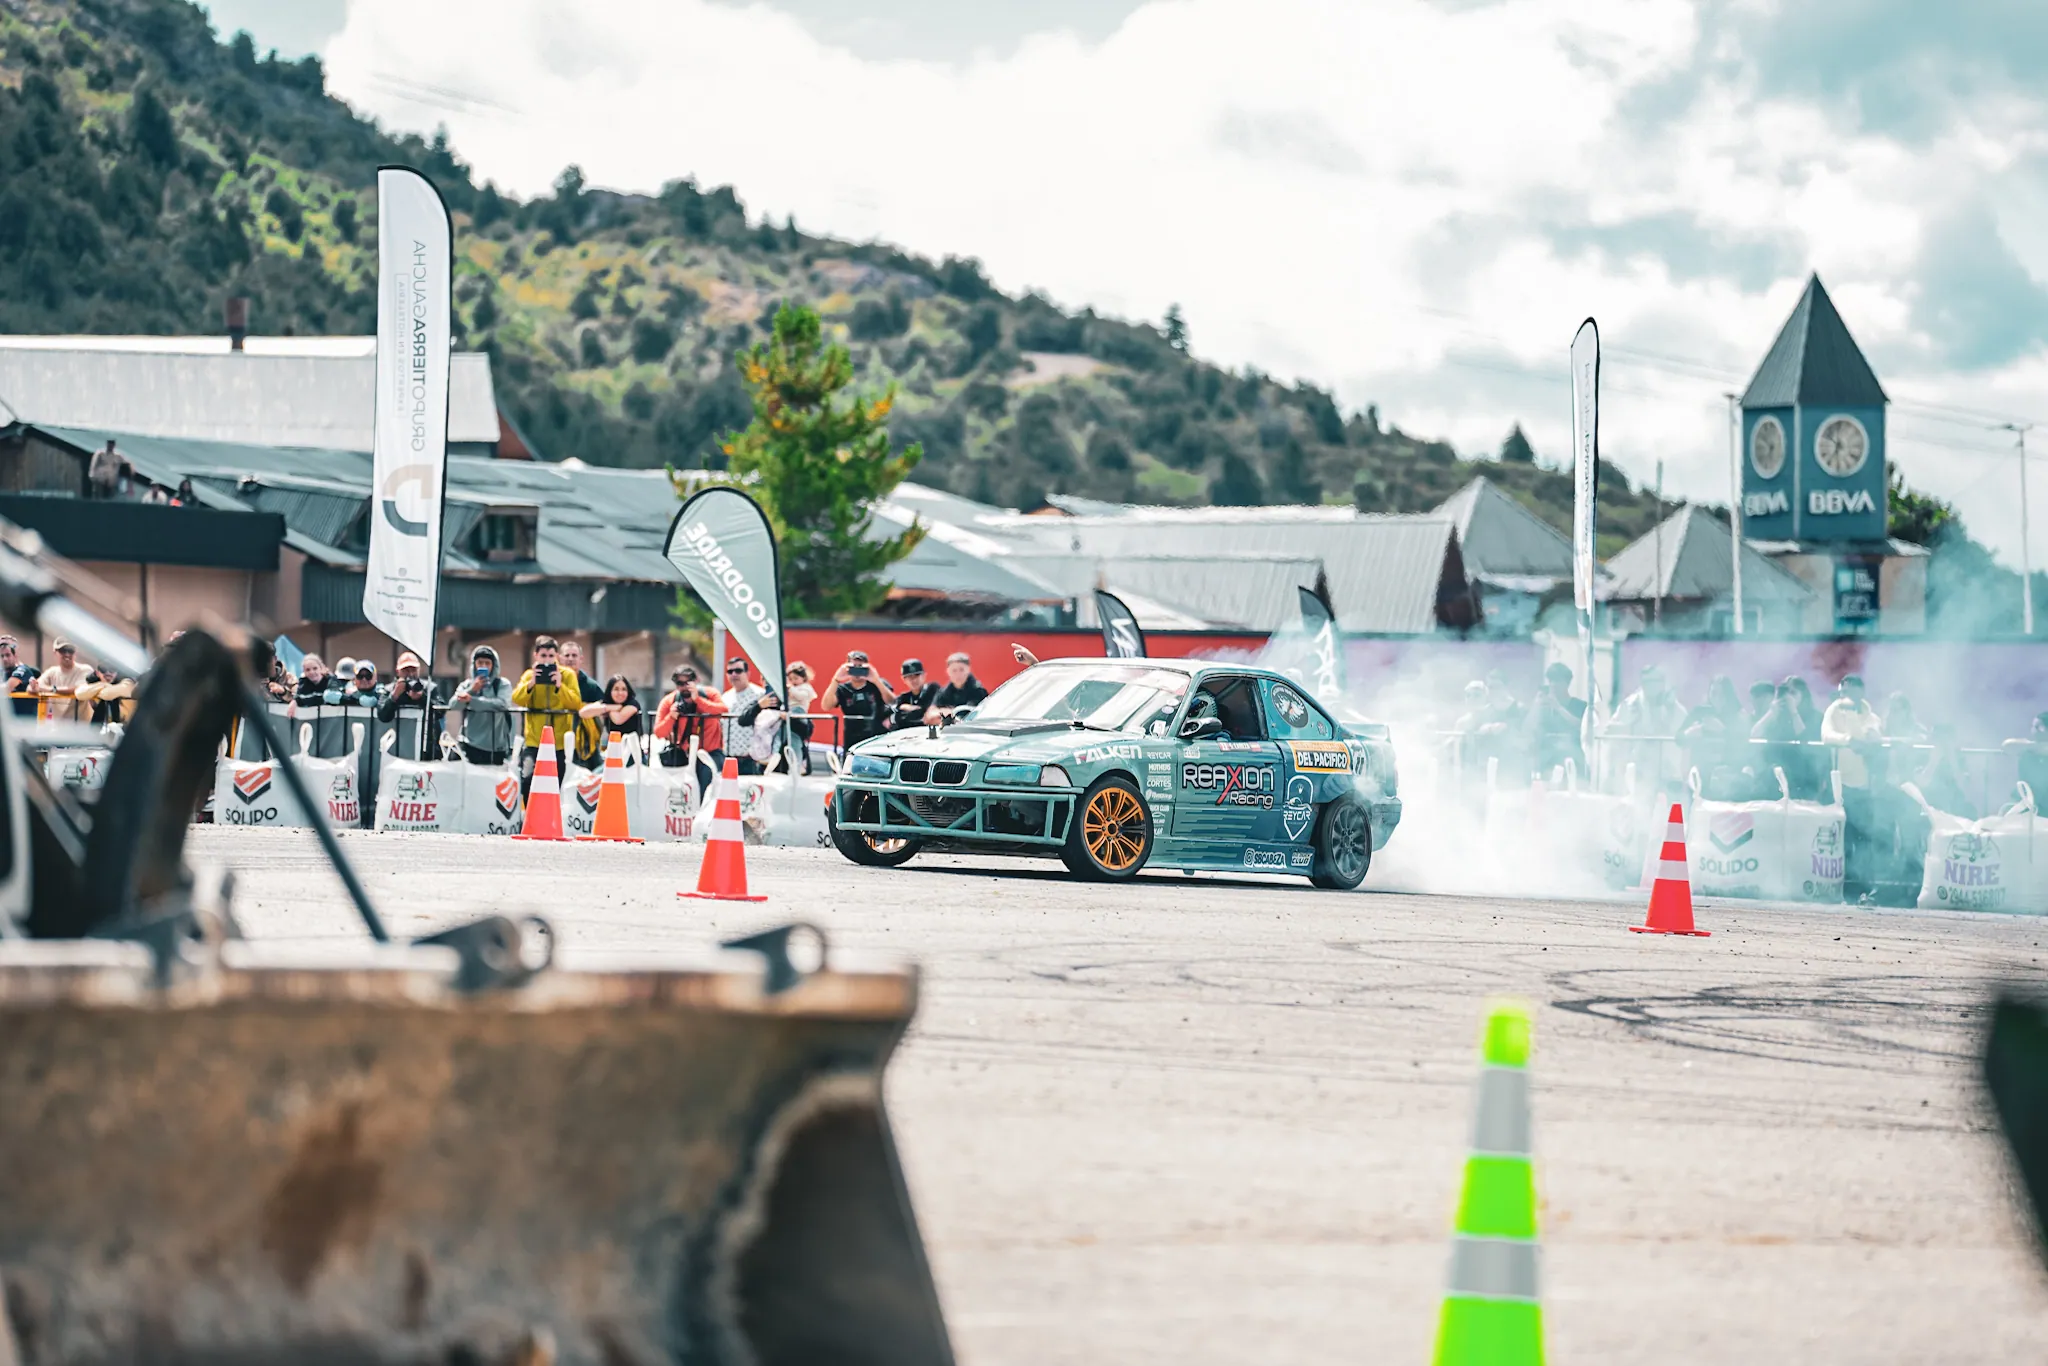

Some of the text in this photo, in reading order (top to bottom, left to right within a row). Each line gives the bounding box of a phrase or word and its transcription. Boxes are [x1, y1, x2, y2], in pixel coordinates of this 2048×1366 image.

[1808, 489, 1876, 515] BBVA
[1073, 744, 1143, 765] FALKEN
[1297, 751, 1347, 769] DEL PACIFICO
[1229, 790, 1275, 809] Racing
[328, 800, 359, 821] NIRE
[389, 800, 438, 821] NIRE
[1283, 811, 1310, 820] REYCAR
[664, 815, 696, 836] NIR
[1944, 859, 2000, 886] NIRE
